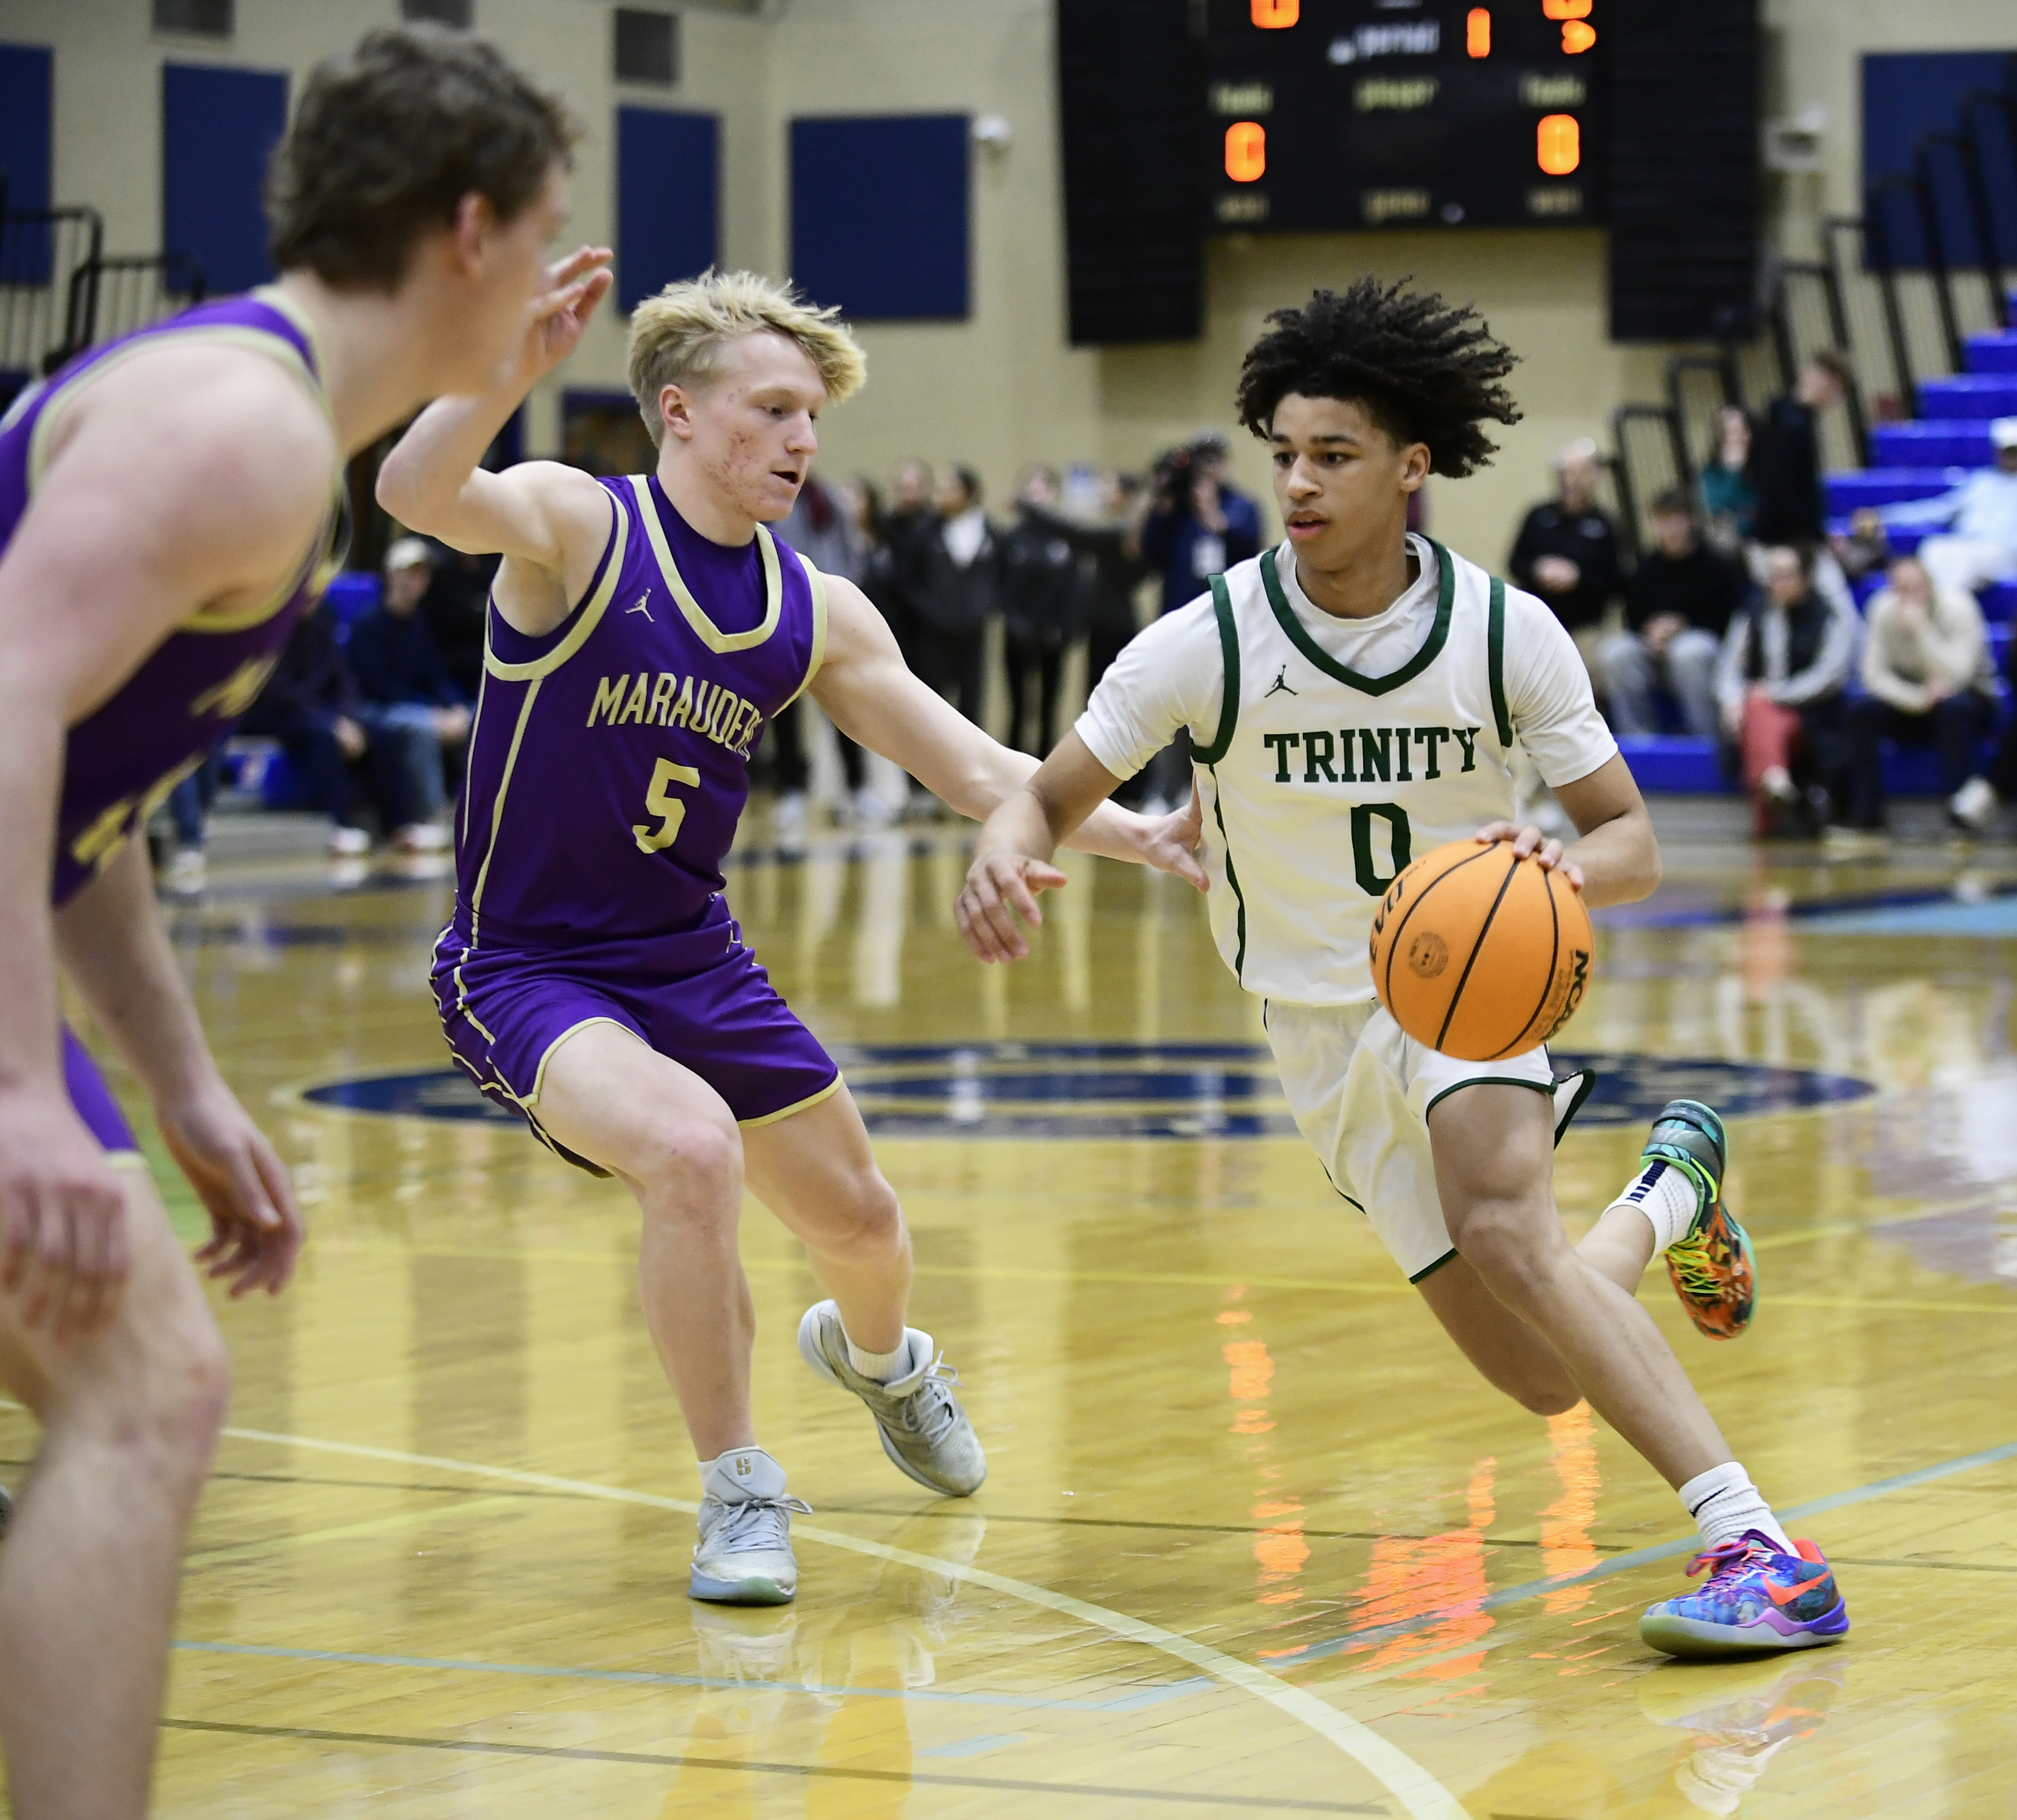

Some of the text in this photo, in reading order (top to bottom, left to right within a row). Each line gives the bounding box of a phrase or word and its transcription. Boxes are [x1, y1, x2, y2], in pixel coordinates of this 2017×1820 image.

[1264, 727, 1481, 783] TRINITY
[632, 757, 701, 854] 5
[1350, 802, 1411, 896] 0
